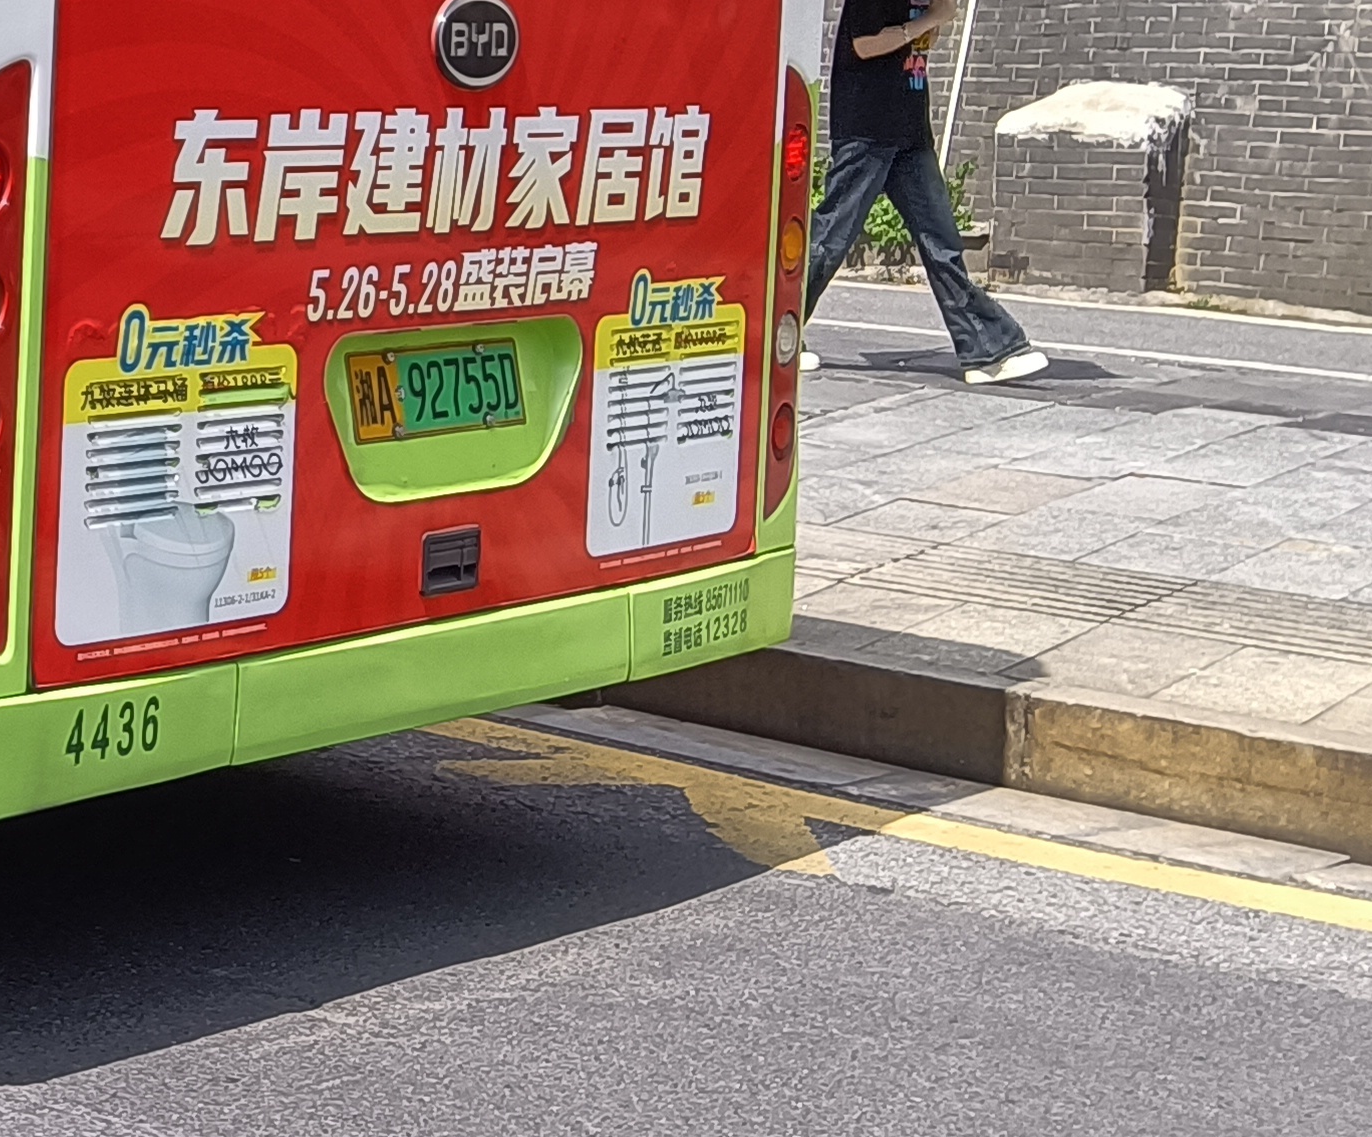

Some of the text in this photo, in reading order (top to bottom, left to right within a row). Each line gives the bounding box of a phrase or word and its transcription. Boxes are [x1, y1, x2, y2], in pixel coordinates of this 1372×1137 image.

[450, 22, 509, 57] BYD
[160, 104, 710, 246] 东岸建材家居馆
[307, 240, 598, 323] 5.26-5.28盛装启幕
[631, 273, 716, 327] 0元秒杀
[119, 309, 251, 374] 0元秒杀
[195, 452, 283, 484] JOMOO
[64, 694, 161, 766] 4436
